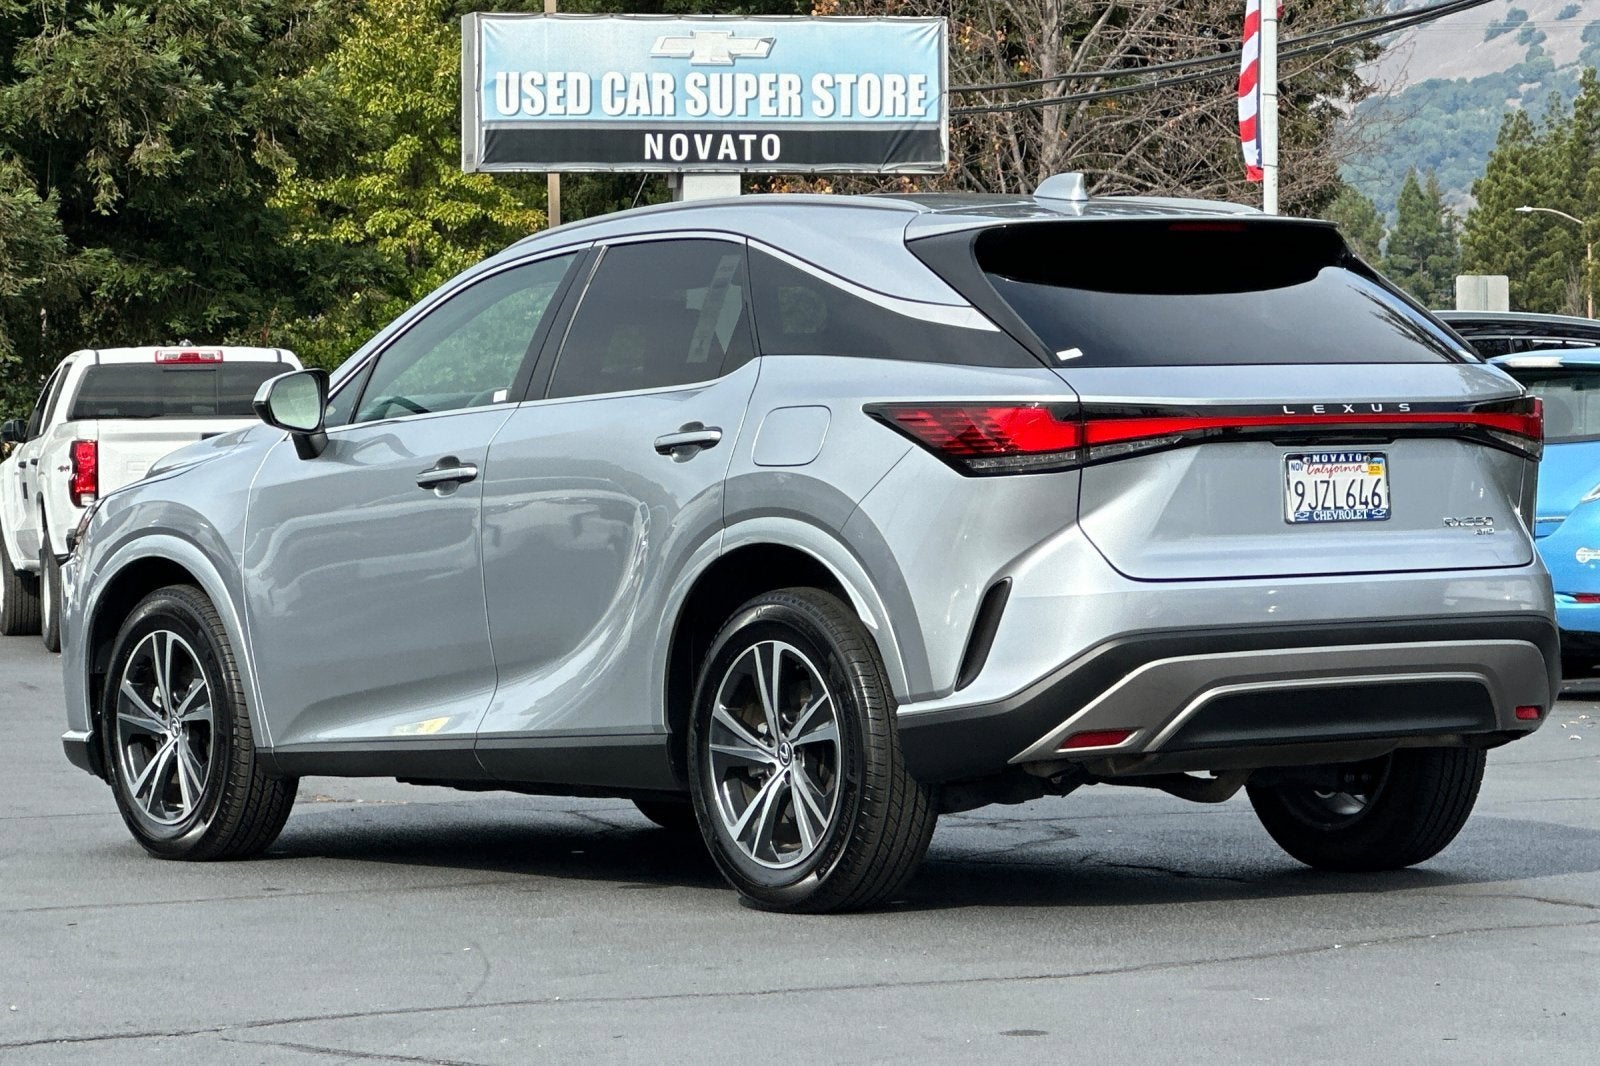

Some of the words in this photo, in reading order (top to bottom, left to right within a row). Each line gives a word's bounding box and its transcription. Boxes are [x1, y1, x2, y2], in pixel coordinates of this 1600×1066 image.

[494, 71, 591, 117] USED
[601, 71, 675, 117] CAR
[685, 71, 802, 118] SUPER
[811, 72, 927, 118] STORE
[644, 133, 781, 162] NOVATO
[1283, 403, 1411, 414] LEXUS
[1312, 453, 1362, 463] NOVATO
[1290, 462, 1304, 472] NOV
[1307, 463, 1368, 479] California
[1294, 478, 1382, 511] 9JZL646
[1313, 509, 1369, 521] CHEVROLET
